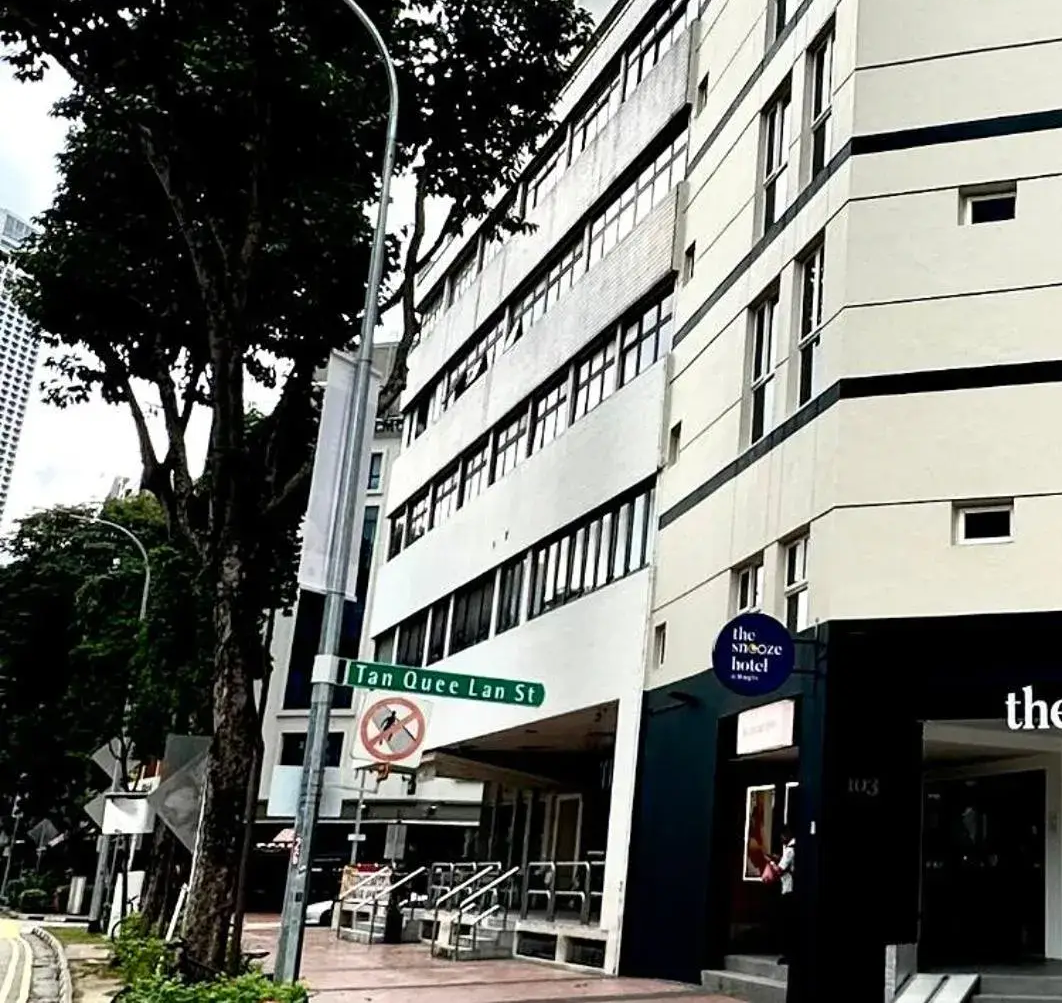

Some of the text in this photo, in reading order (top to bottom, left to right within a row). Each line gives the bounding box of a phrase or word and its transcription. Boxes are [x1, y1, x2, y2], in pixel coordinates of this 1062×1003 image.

[733, 626, 756, 641] the
[732, 643, 783, 656] snooze
[732, 656, 768, 673] hotel
[356, 664, 535, 704] Tan Quee Lan St
[848, 776, 880, 796] 103
